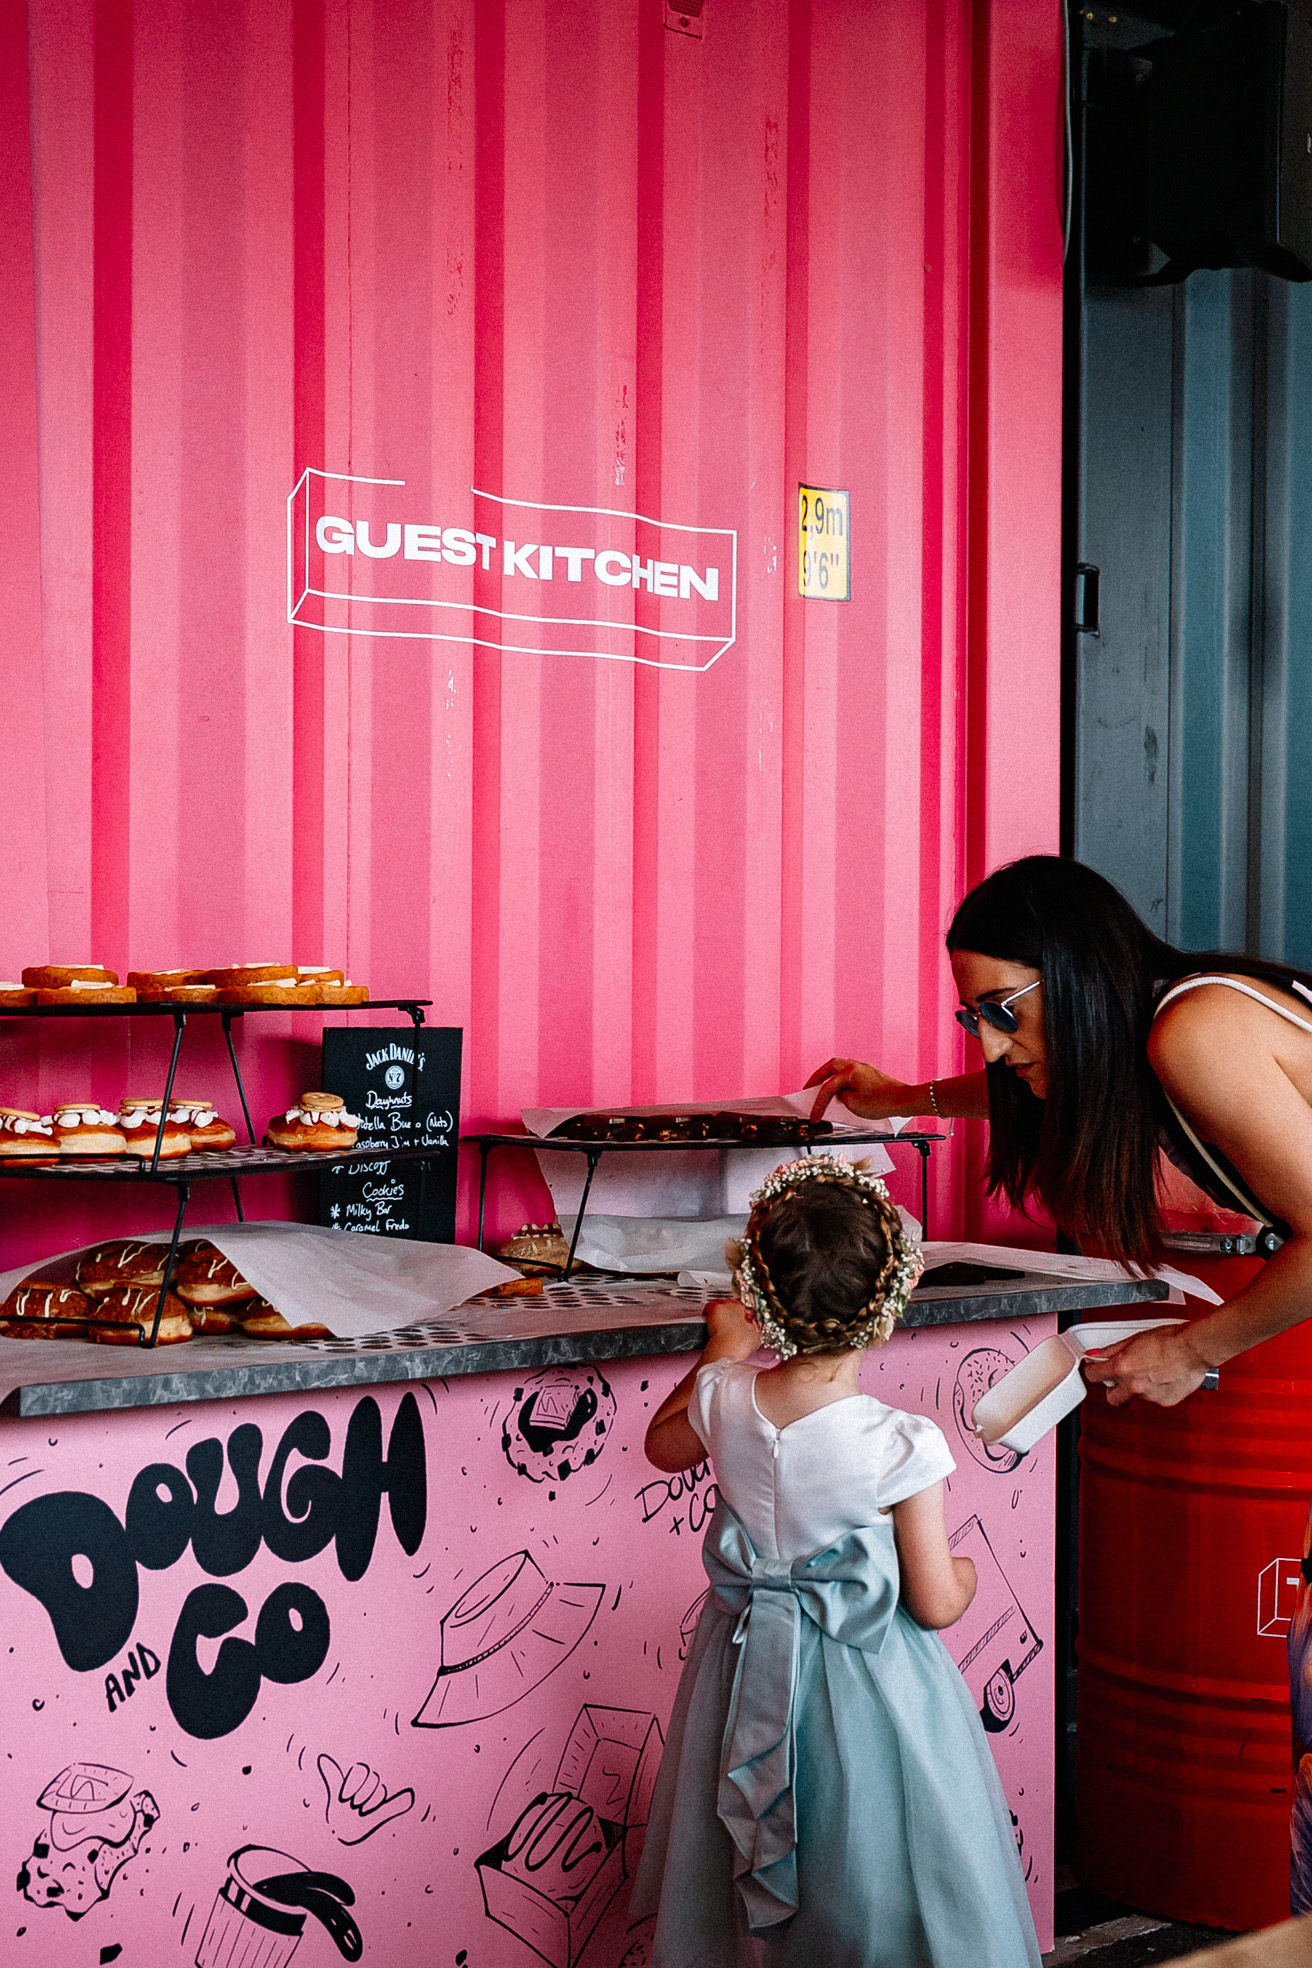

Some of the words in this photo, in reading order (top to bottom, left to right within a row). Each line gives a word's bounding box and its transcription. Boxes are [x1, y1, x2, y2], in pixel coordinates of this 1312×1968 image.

[315, 515, 497, 570] GUEST
[502, 541, 719, 601] KITCHEN
[365, 1047, 390, 1071] JACK
[356, 1112, 387, 1131] utella
[387, 1111, 422, 1132] Bueo
[362, 1178, 405, 1202] Cookies
[345, 1203, 372, 1222] Milky
[343, 1219, 381, 1233] Caramel
[0, 1391, 428, 1672] DOUGH
[104, 1642, 162, 1713] AND
